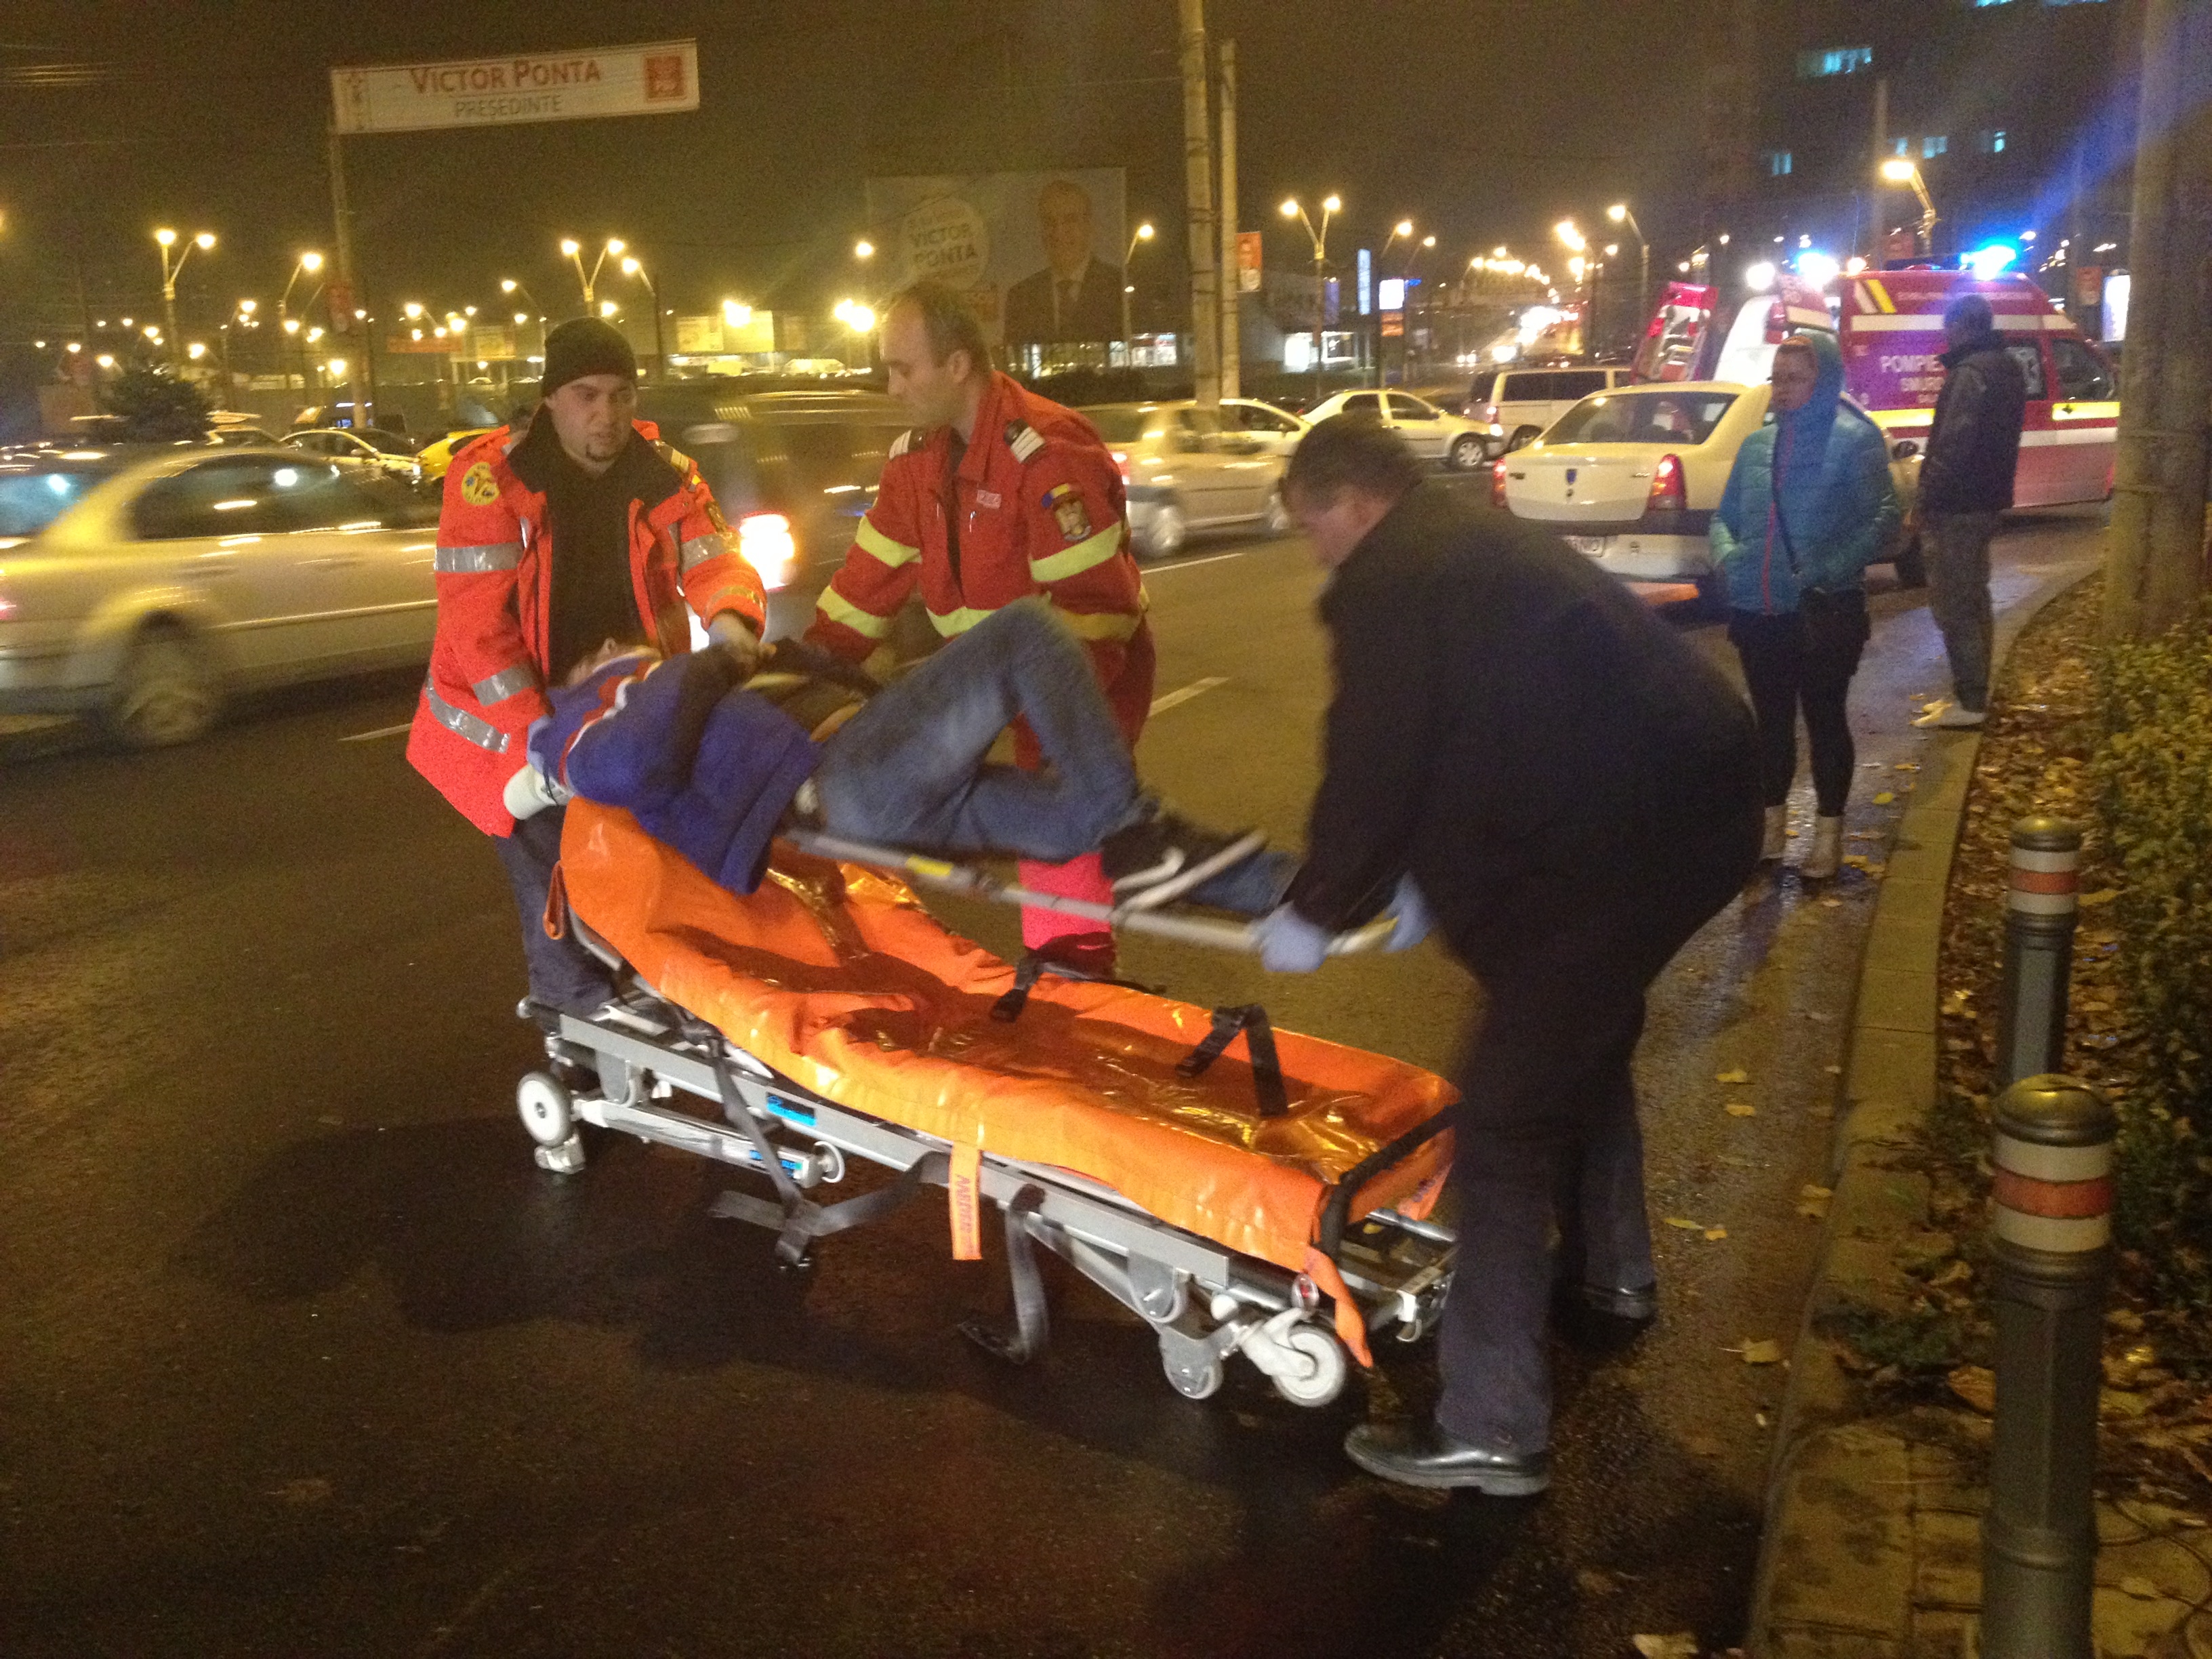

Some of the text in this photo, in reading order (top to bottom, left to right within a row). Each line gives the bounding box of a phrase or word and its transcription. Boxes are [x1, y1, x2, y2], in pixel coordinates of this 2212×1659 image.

[409, 60, 601, 94] VICTOR PONTA
[909, 223, 972, 247] VICTOR
[914, 243, 977, 268] PONTA
